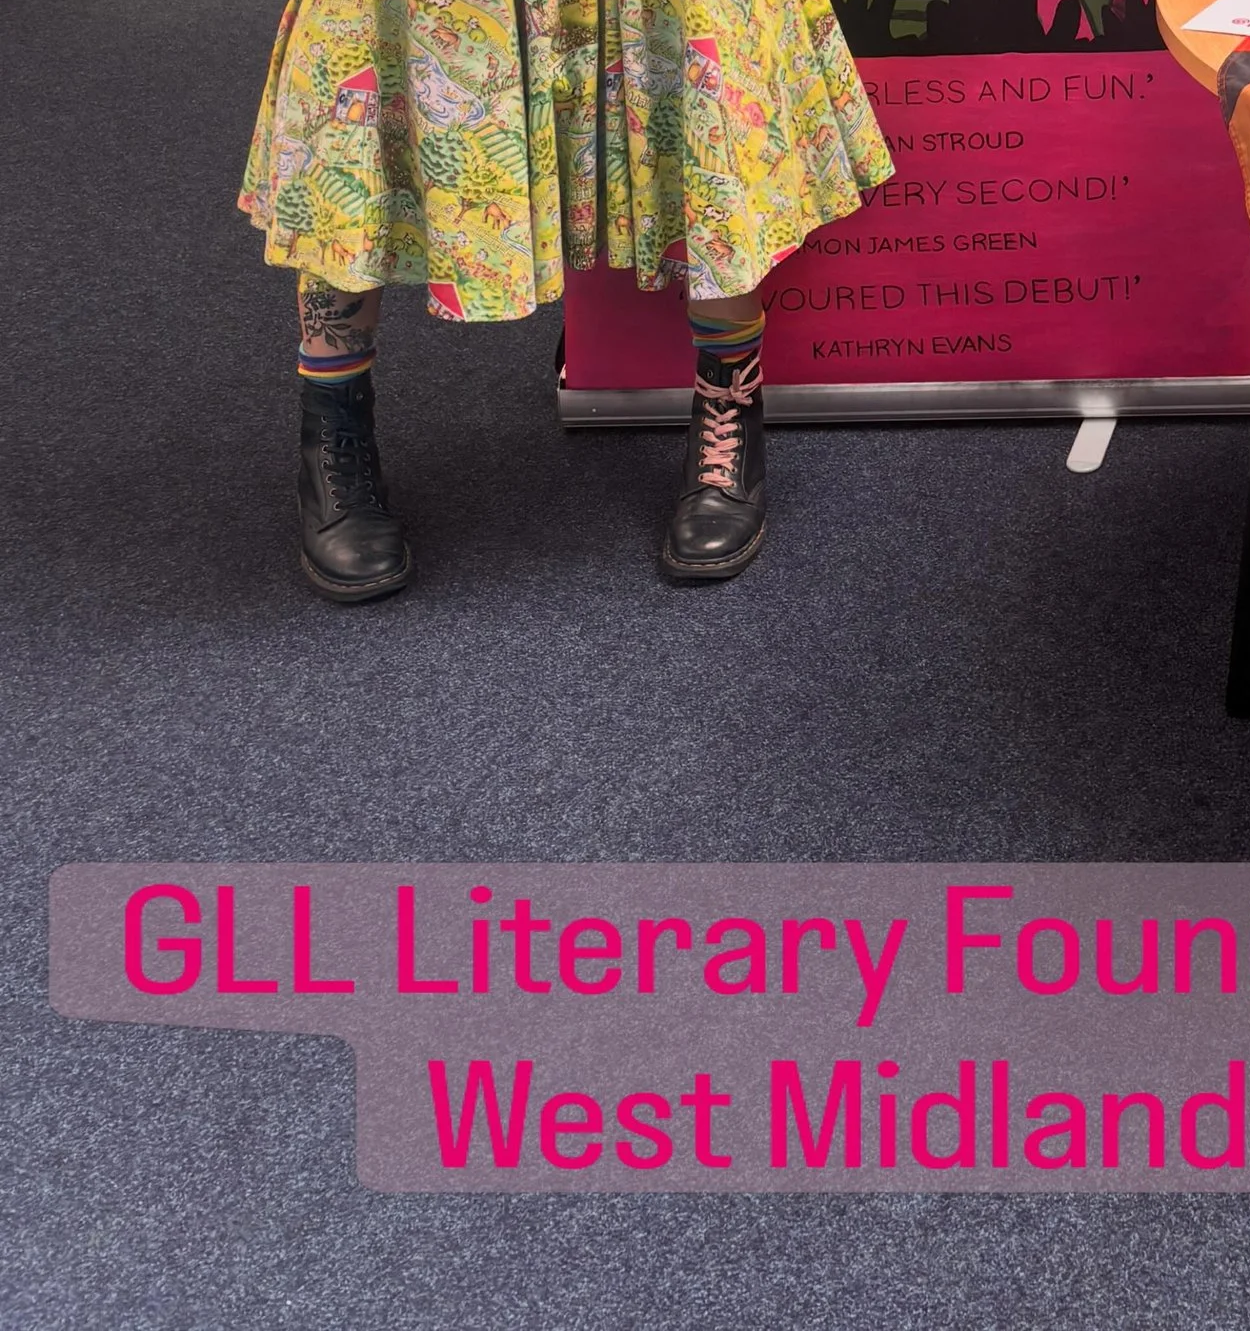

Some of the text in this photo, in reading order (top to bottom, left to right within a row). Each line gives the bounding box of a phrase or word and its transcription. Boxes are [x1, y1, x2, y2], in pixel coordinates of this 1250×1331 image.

[979, 78, 1050, 102] AND
[922, 130, 1025, 152] STROUD
[867, 234, 945, 255] JAMES
[952, 231, 1038, 252] GREEN
[918, 280, 993, 307] THIS
[811, 332, 1013, 359] KATHRYN EVANS
